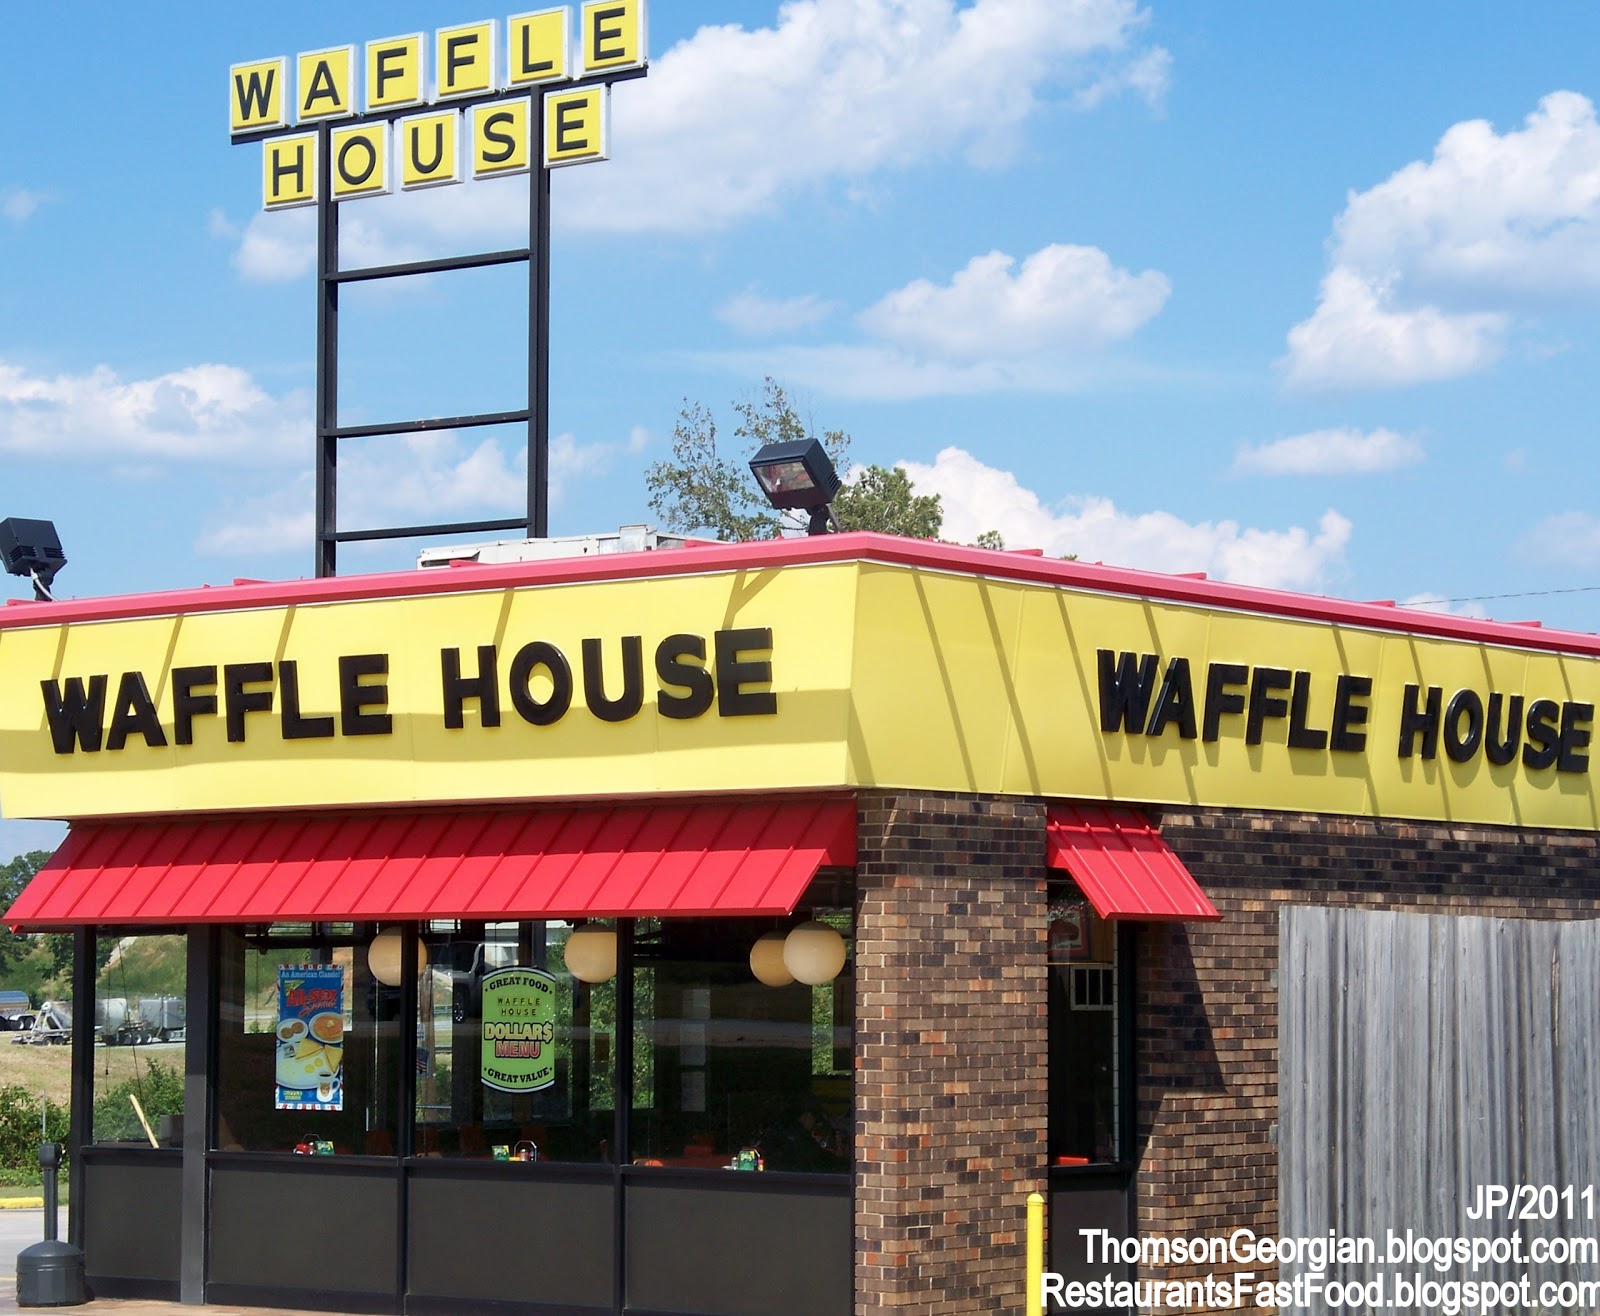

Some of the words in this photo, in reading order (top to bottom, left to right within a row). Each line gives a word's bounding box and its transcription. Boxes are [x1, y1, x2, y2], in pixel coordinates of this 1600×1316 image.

[235, 6, 626, 121] WAFFLE
[272, 98, 589, 197] HOUSE
[40, 653, 393, 754] WAFFLE
[440, 627, 777, 730] HOUSE
[1096, 648, 1373, 753] WAFFLE
[1398, 684, 1595, 773] HOUSE
[489, 976, 521, 991] GREAT
[522, 977, 549, 993] FOOD
[497, 997, 541, 1006] WAFFLE
[501, 1008, 537, 1016] HOUSE
[495, 1041, 540, 1058] MENU
[487, 1067, 519, 1083] GREAT
[520, 1066, 550, 1083] VALUE
